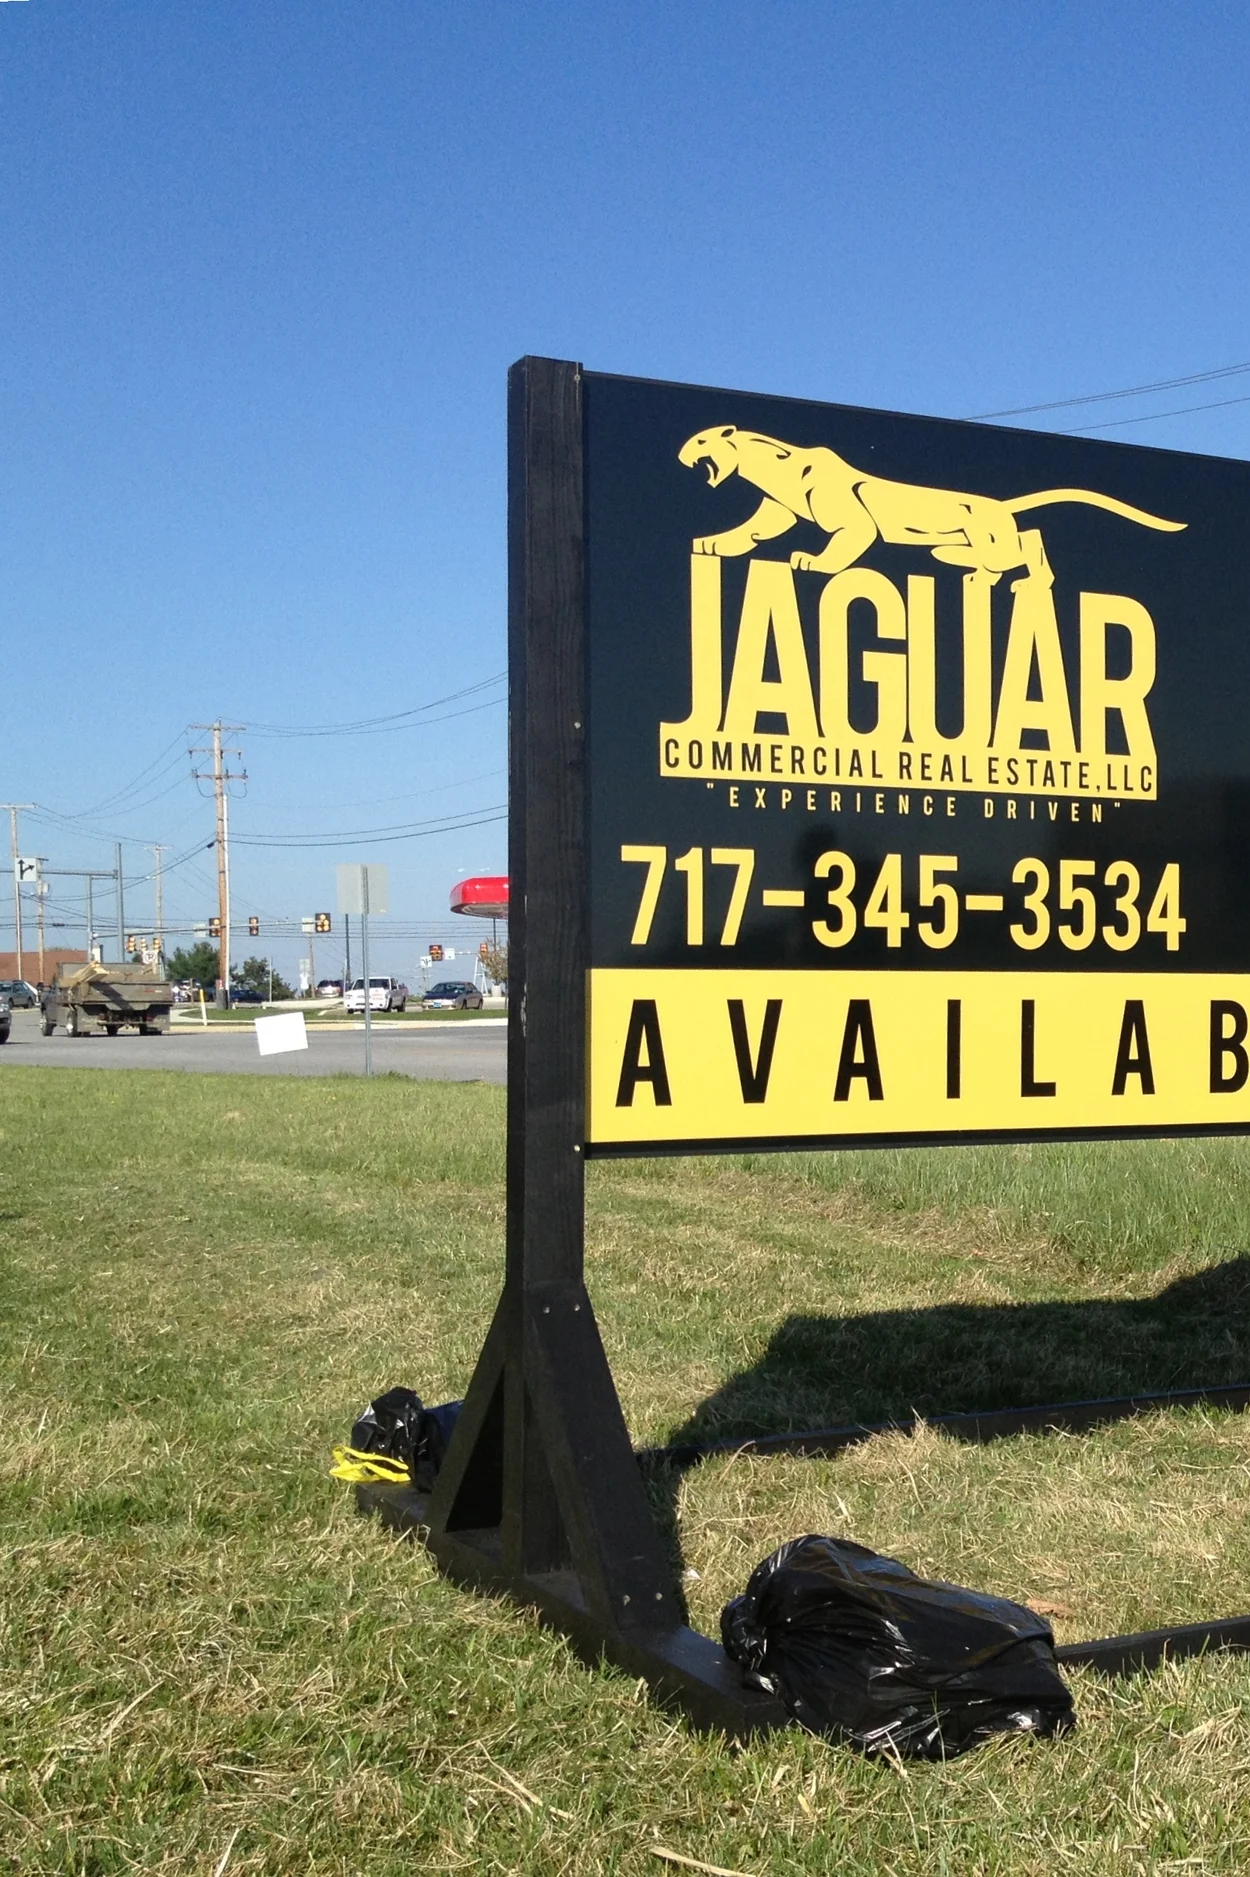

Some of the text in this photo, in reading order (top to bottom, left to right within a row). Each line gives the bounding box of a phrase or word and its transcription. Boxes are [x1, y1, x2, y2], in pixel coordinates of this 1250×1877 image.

[660, 554, 1158, 758] JAGUAR
[665, 738, 883, 780] COMMERCIAL
[899, 751, 973, 784] REAL
[620, 844, 1187, 952] 717-345-3534
